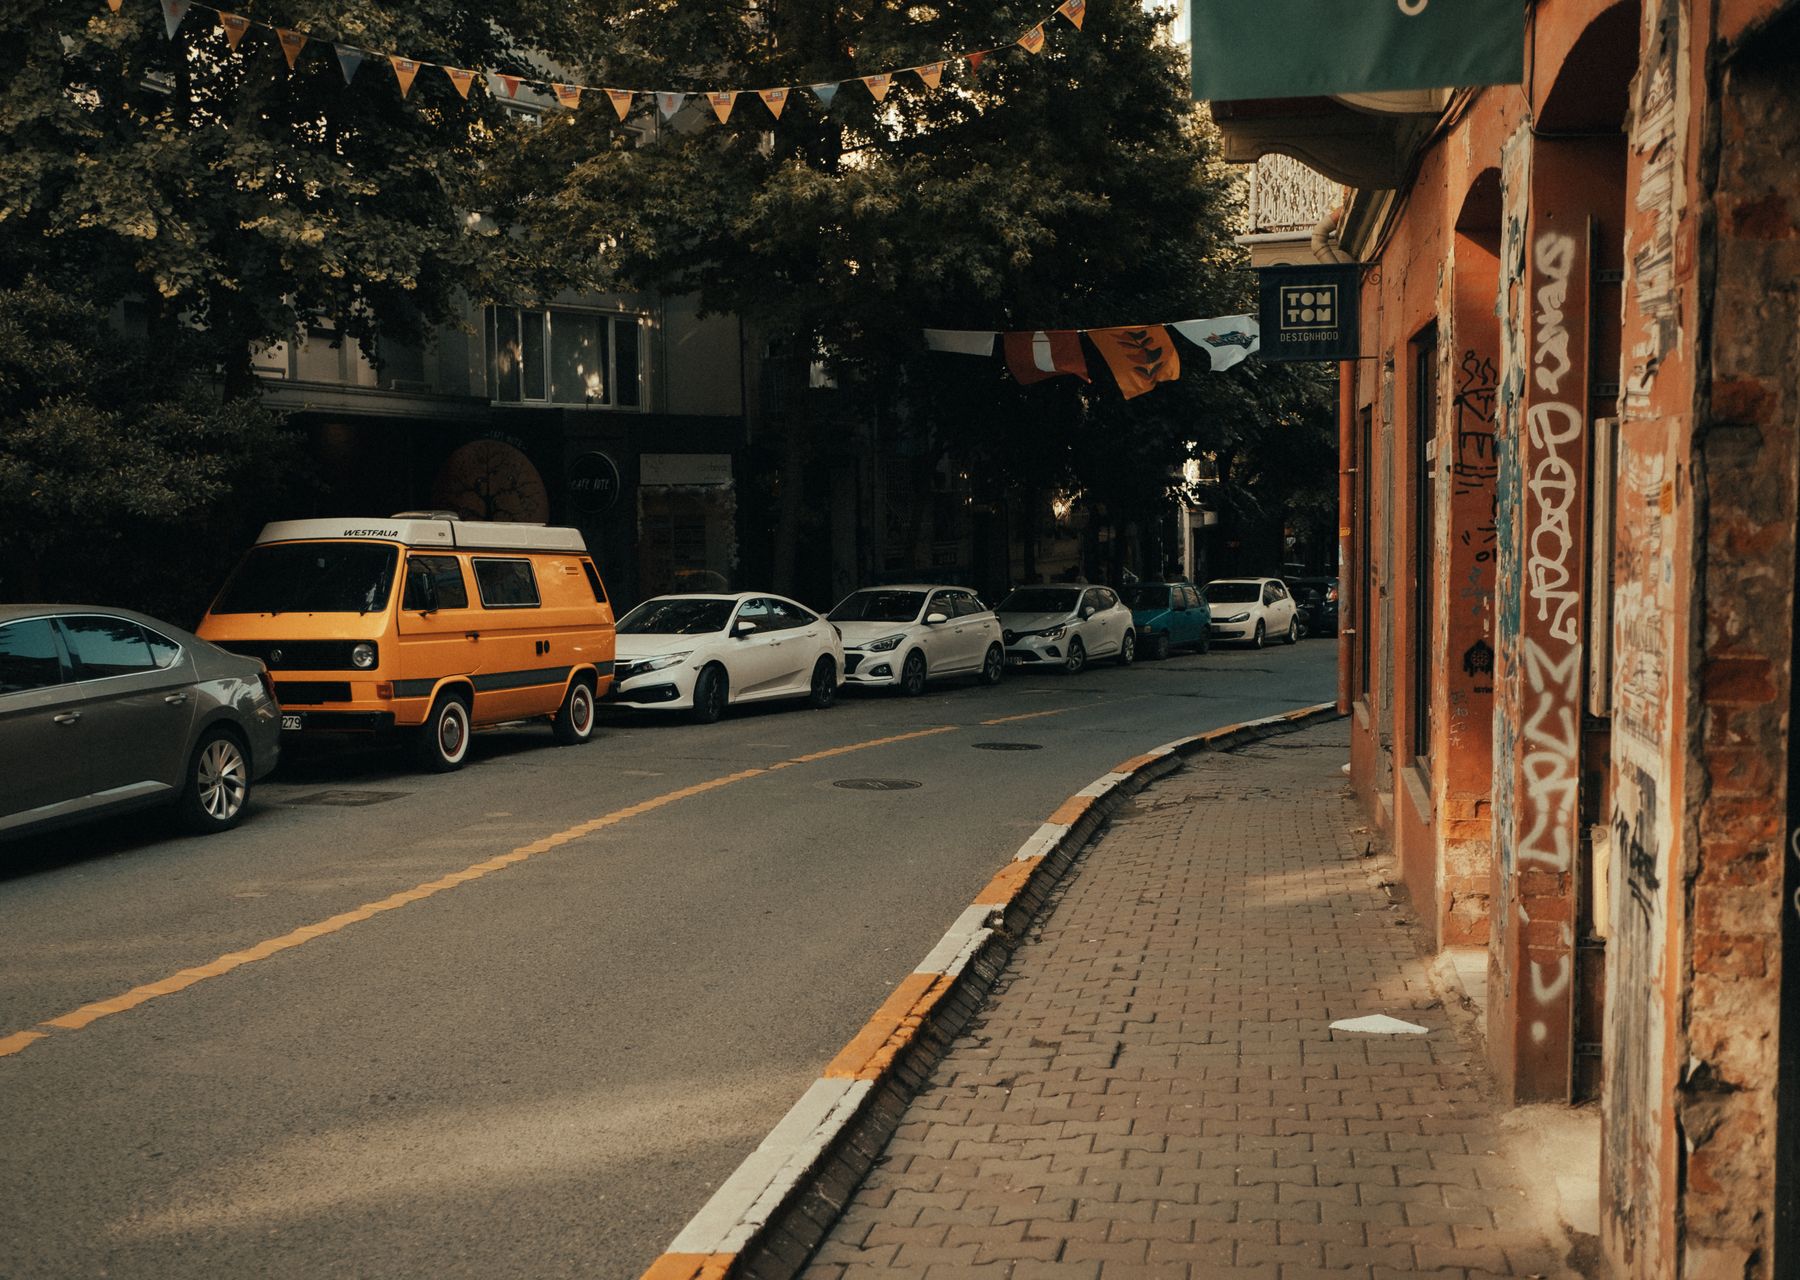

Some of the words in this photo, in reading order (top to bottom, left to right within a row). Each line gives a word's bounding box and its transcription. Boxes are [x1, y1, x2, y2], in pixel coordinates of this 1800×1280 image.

[1287, 291, 1331, 306] TOM
[1287, 308, 1331, 323] TOM
[1280, 331, 1339, 342] DESIGNHOOD
[344, 529, 399, 538] WESTFALIA
[283, 717, 301, 729] 279
